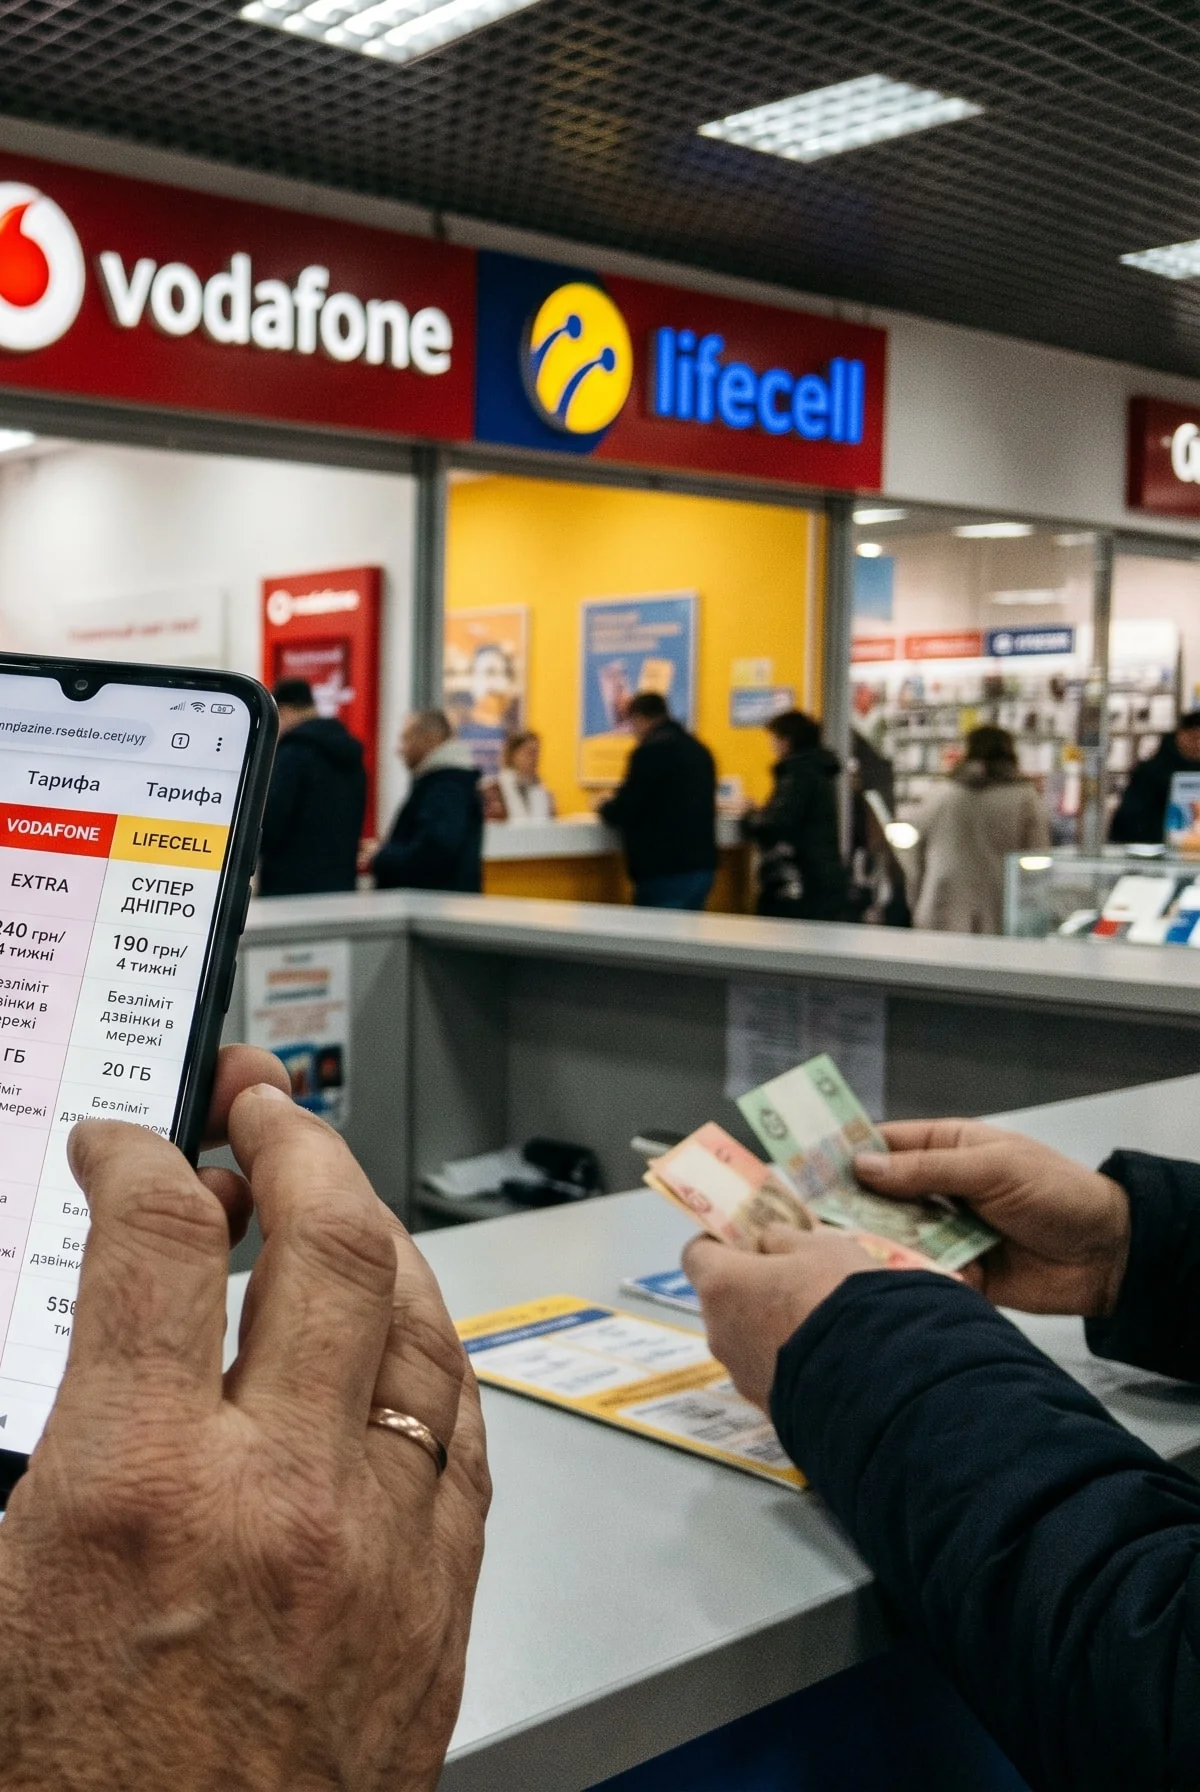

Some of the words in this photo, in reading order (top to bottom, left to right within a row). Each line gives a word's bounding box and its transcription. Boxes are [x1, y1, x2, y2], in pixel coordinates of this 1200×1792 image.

[99, 250, 453, 377] vodafone
[655, 325, 866, 446] lifecell
[27, 770, 100, 794] Тарифа
[146, 781, 222, 807] Тарифа
[7, 817, 101, 842] VODAFONE
[132, 831, 212, 854] LIFECELL
[10, 872, 69, 893] EXTRA
[131, 877, 194, 897] СУПЕР
[120, 896, 196, 918] ДНІПРО
[31, 930, 66, 945] грн/
[113, 934, 149, 953] 190
[152, 945, 189, 960] грн/
[9, 946, 55, 962] тижні
[116, 957, 126, 970] 4
[130, 961, 178, 977] тижні
[39, 1002, 48, 1013] в
[107, 990, 174, 1010] Безліміт
[99, 1011, 161, 1028] дзвінки
[165, 1019, 174, 1030] в
[105, 1030, 163, 1047] мережі
[3, 1047, 26, 1064] ГБ
[102, 1061, 125, 1078] 20
[129, 1065, 152, 1082] ГБ
[91, 1096, 150, 1115] Безліміт
